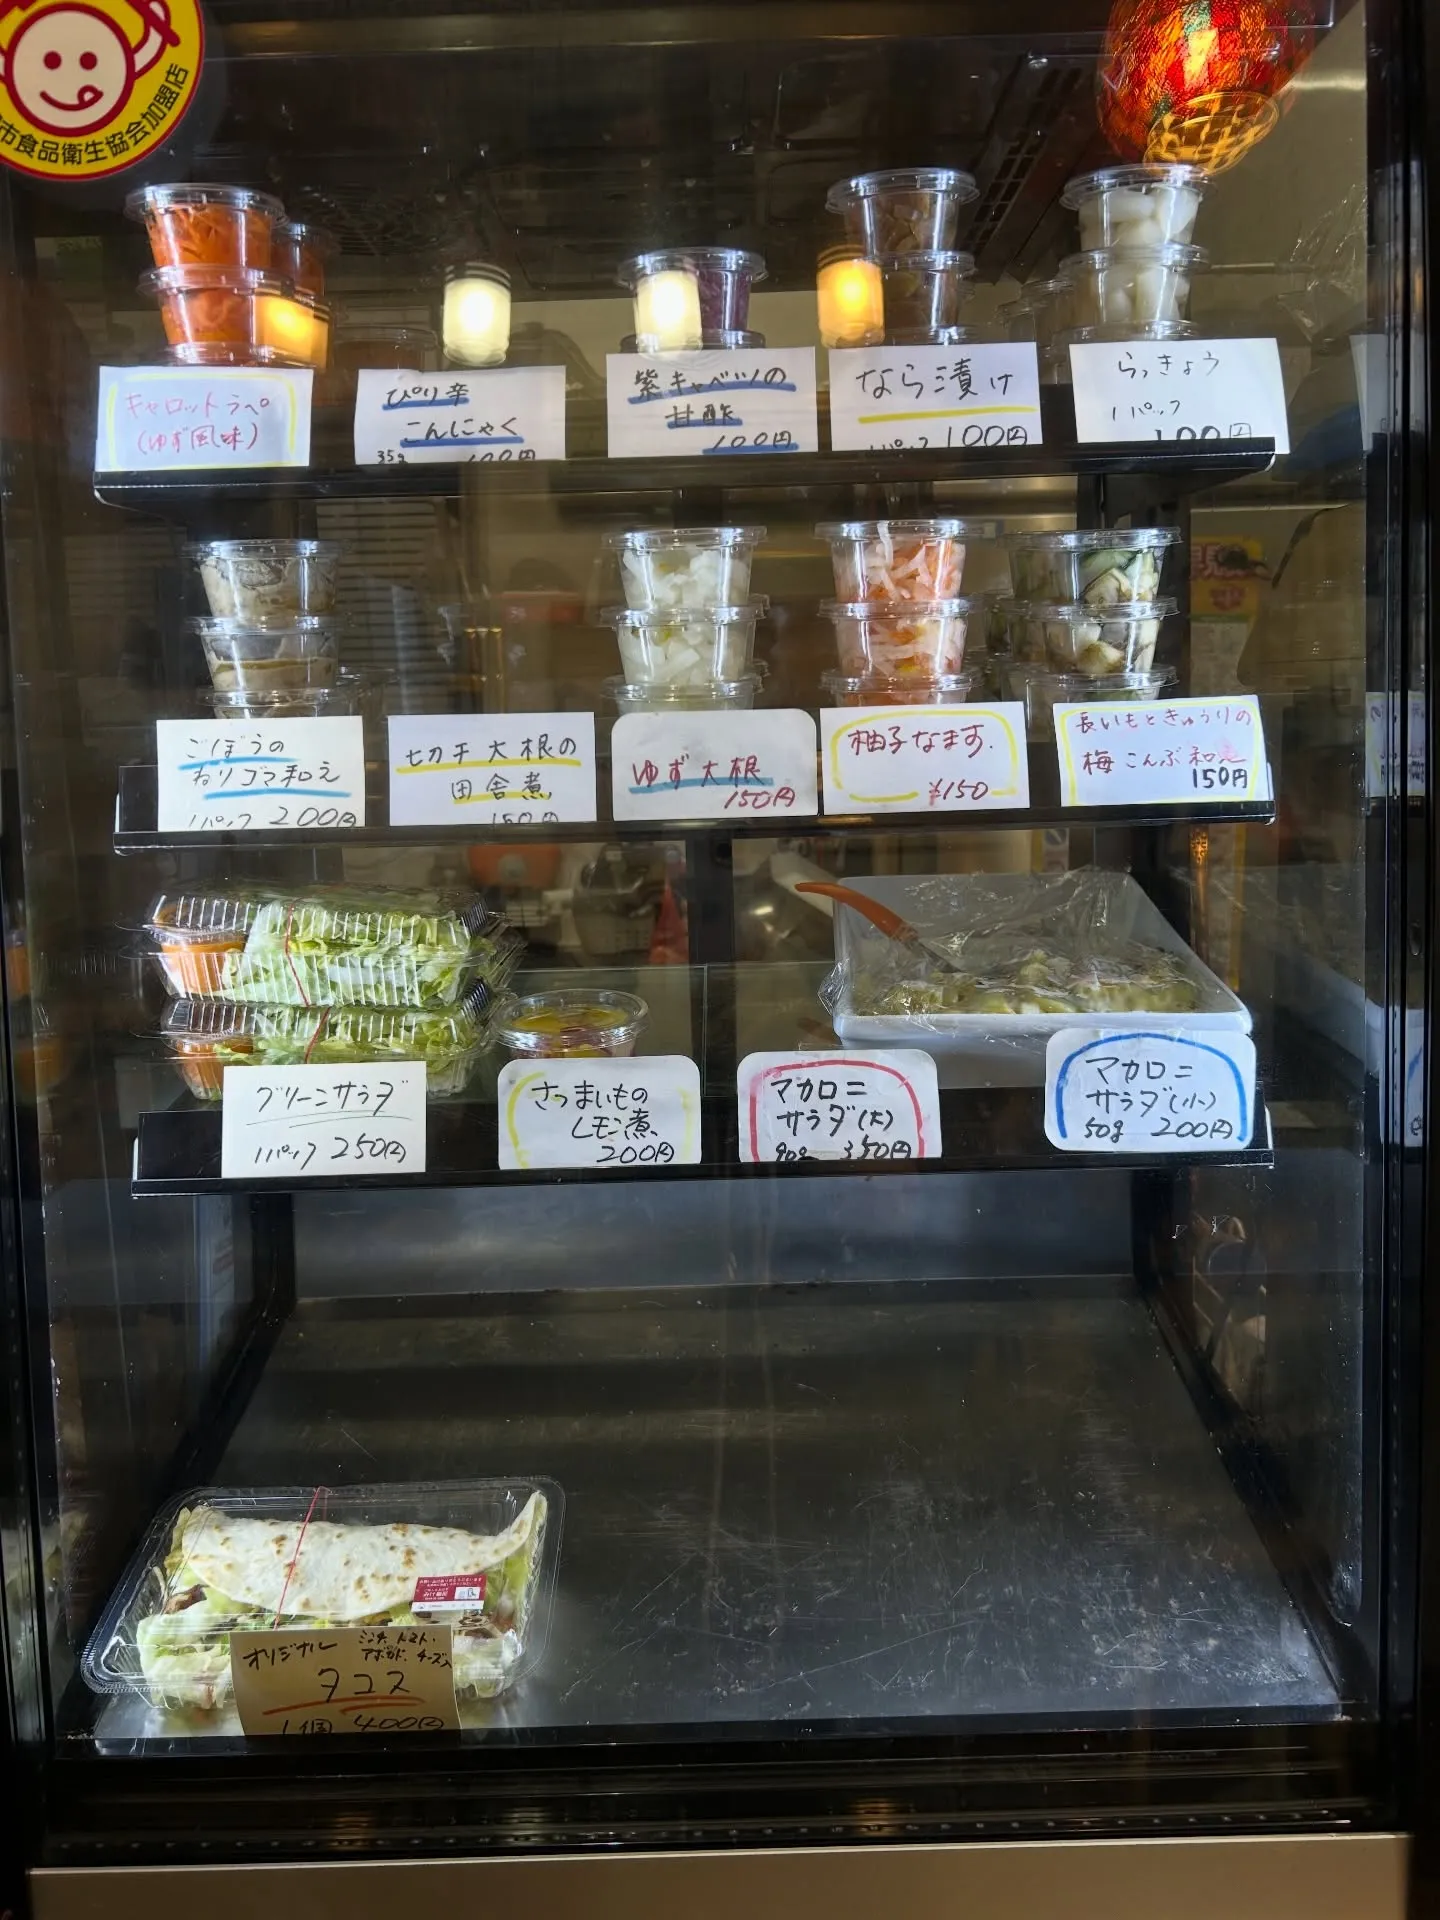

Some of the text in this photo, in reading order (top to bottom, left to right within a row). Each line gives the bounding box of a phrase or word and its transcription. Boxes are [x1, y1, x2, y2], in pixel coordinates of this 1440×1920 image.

[0, 64, 189, 165] 市食品衛生協会加盟店
[856, 358, 1013, 400] なら漬け
[1118, 351, 1219, 379] らっきょう
[387, 382, 469, 407] ぴり辛
[665, 403, 734, 427] 甘酢
[403, 417, 517, 443] こんにゃく
[712, 430, 792, 450] 100円
[632, 754, 765, 789] ゆず大根
[1192, 767, 1248, 789] 150円
[451, 772, 552, 801] 田舎煮
[724, 787, 795, 809] 150円
[269, 806, 357, 827] 200円
[1086, 1056, 1193, 1085] マカロニ
[257, 1080, 409, 1116] グリーンサラダ
[770, 1078, 868, 1103] マカロニ
[1084, 1116, 1233, 1144] 50g 200円
[331, 1133, 407, 1163] 250円
[596, 1142, 675, 1164] 200円
[243, 1642, 338, 1670] オリジナル
[318, 1668, 411, 1703] タコス
